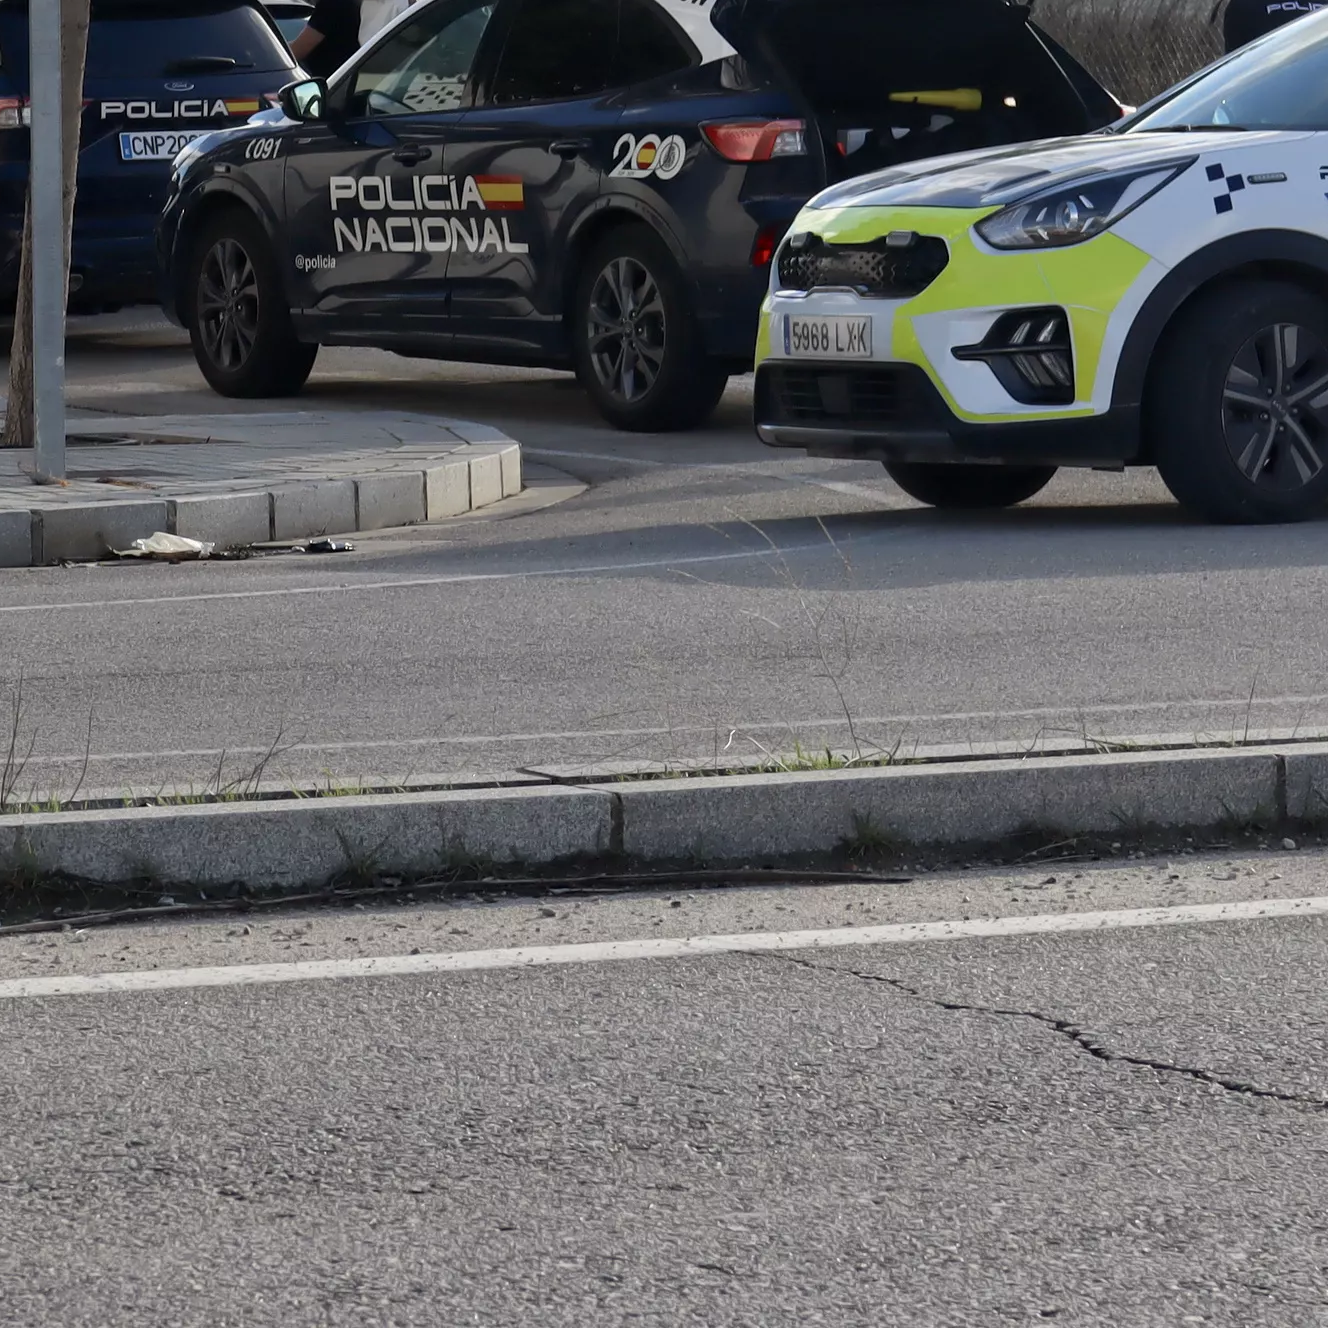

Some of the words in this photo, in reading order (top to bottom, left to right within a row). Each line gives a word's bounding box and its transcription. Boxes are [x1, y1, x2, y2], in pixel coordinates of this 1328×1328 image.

[254, 138, 282, 159] 091
[329, 175, 486, 210] POLICÍA
[333, 217, 529, 253] NACIONAL
[793, 322, 829, 352] 5968
